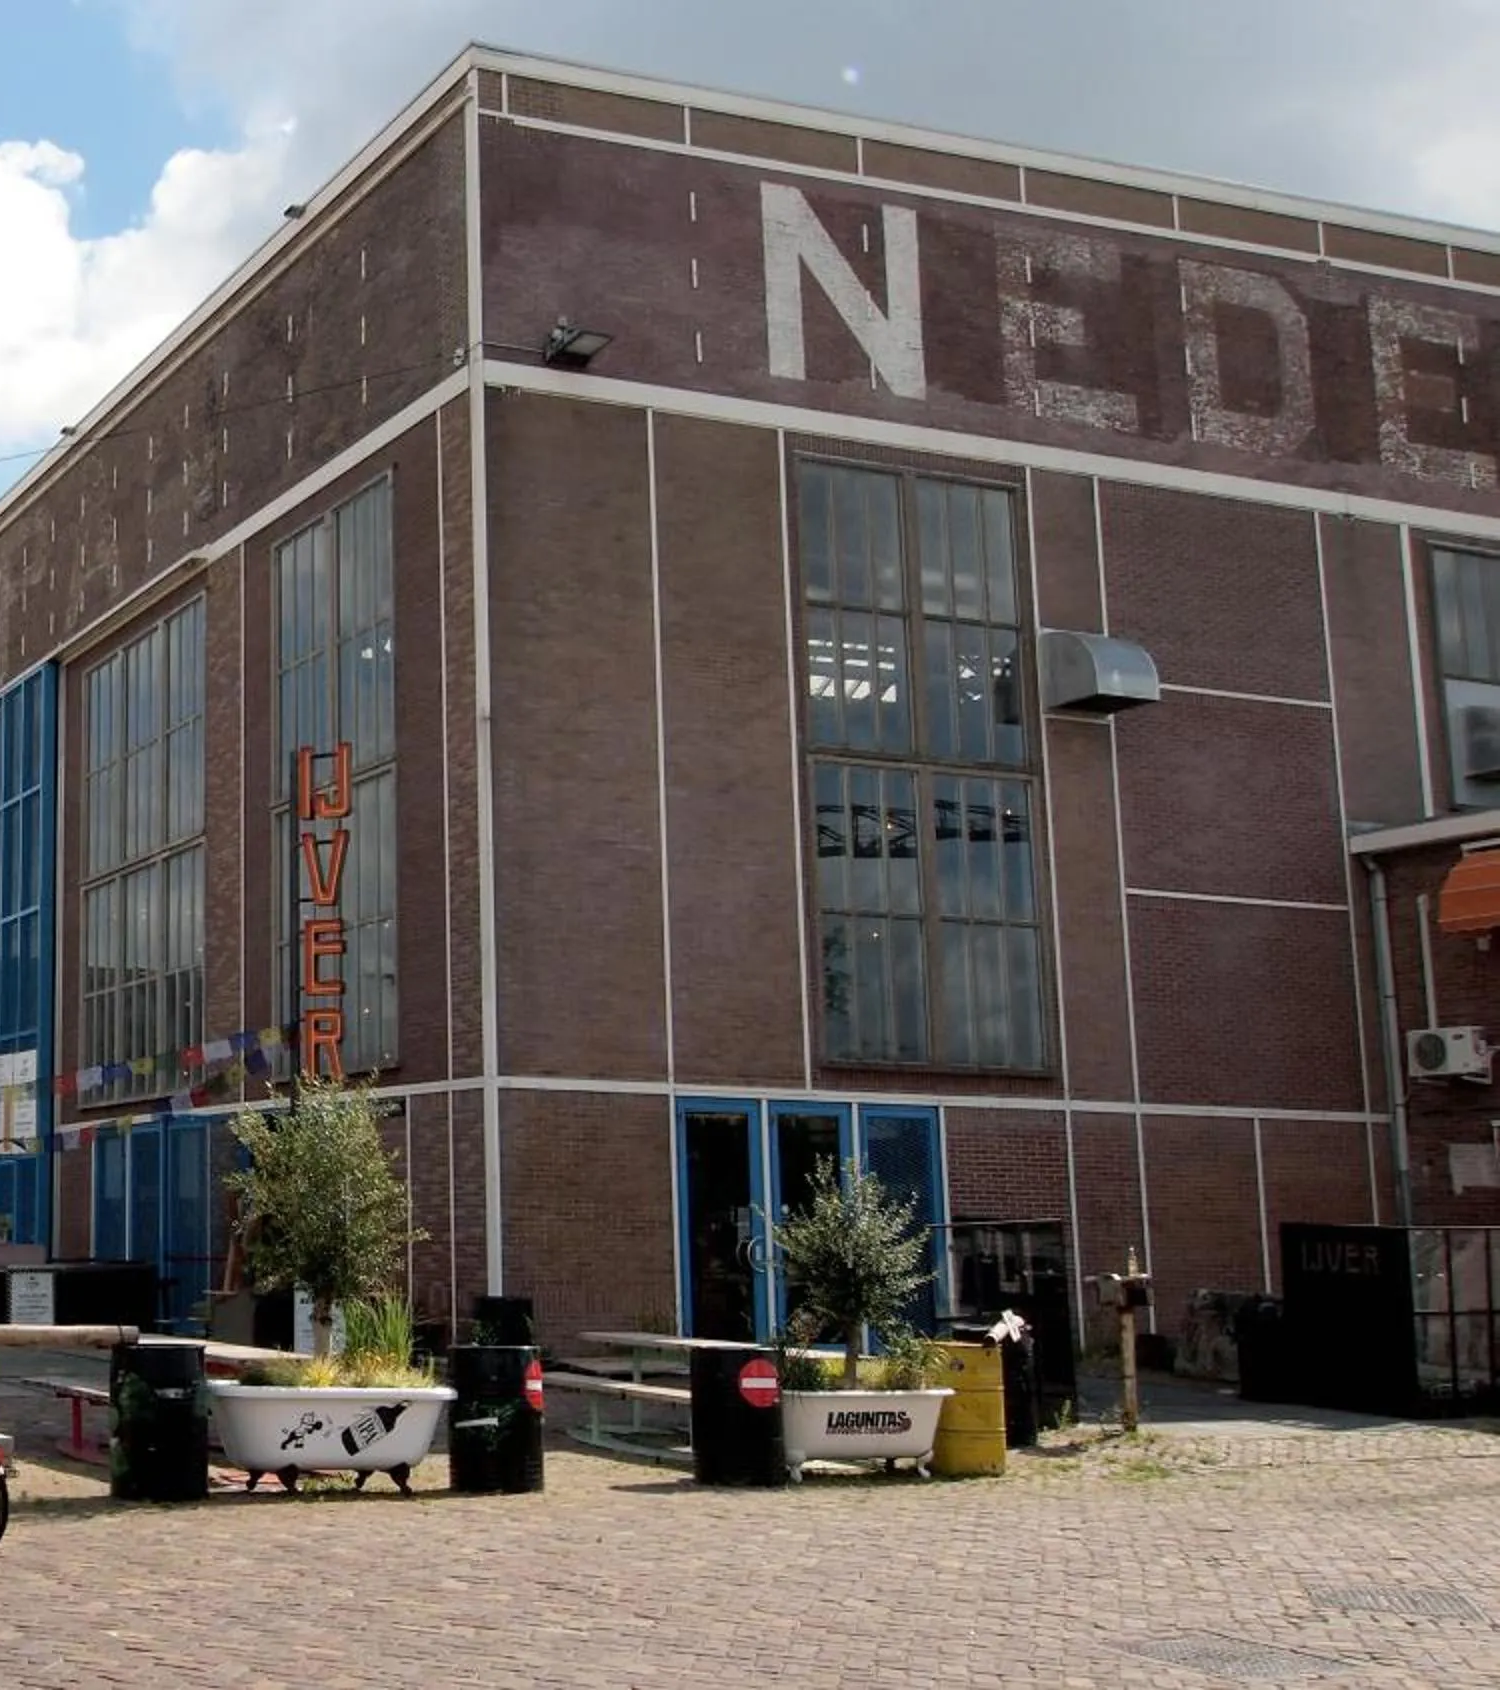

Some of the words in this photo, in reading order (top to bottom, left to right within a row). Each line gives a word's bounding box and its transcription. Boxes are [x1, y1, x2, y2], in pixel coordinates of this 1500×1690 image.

[298, 742, 352, 1080] IJVER
[1301, 1240, 1381, 1275] IJVER
[827, 1411, 907, 1429] LAGUNITAS
